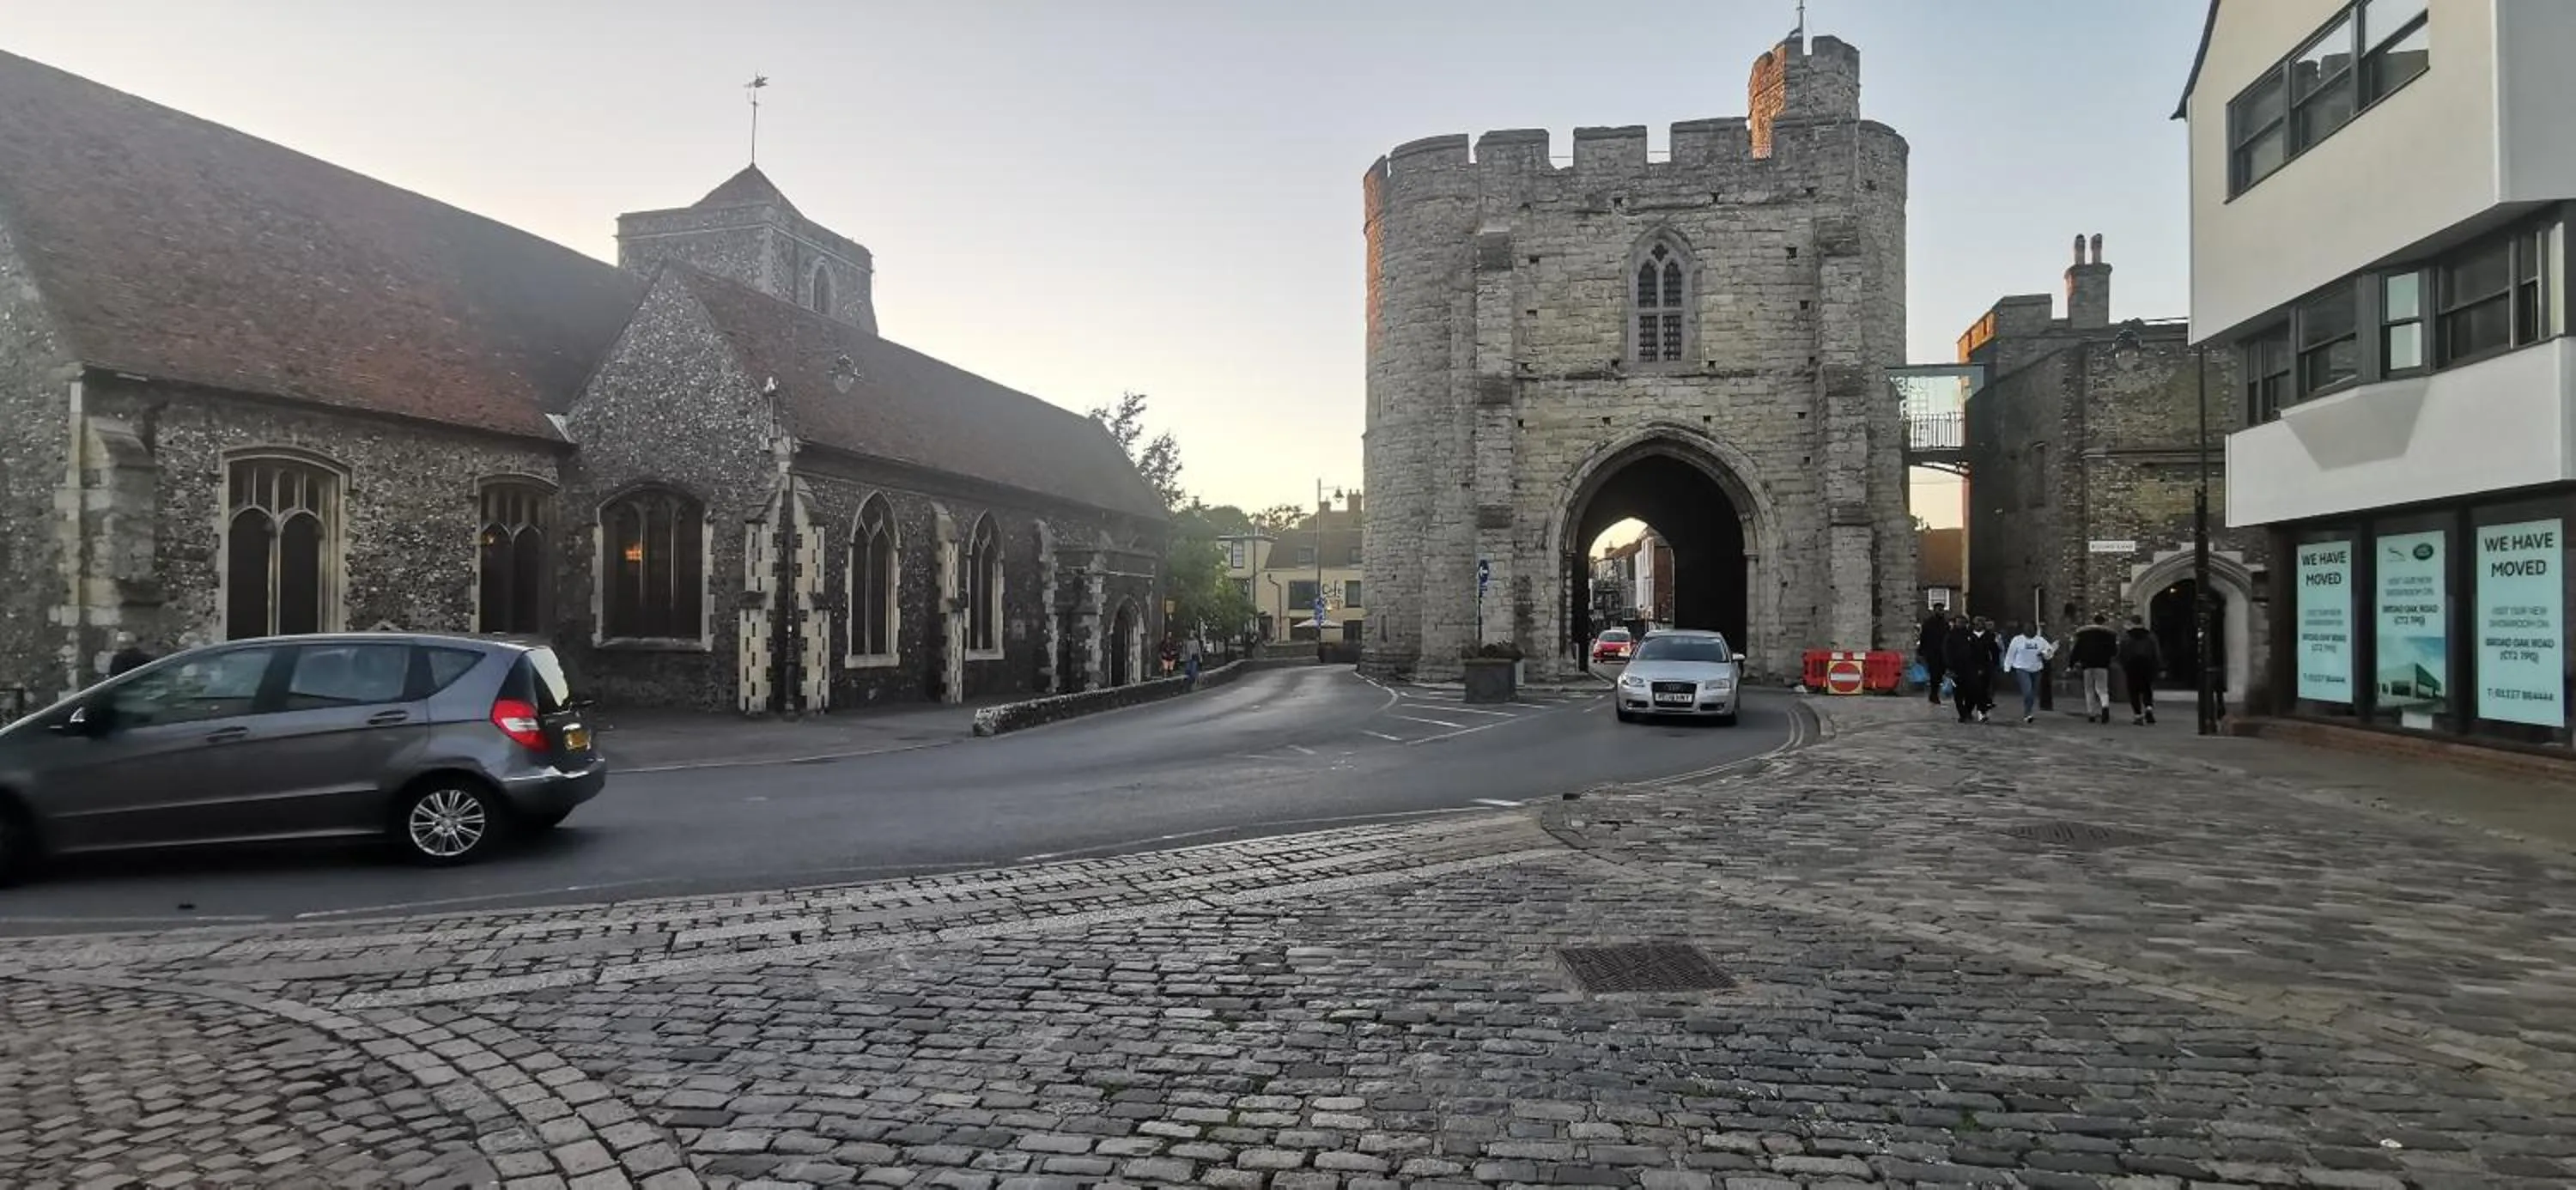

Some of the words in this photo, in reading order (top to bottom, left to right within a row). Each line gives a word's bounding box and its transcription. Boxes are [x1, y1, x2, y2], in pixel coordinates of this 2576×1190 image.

[2484, 536, 2508, 552] WE
[2512, 531, 2554, 550] HAVE
[2302, 554, 2317, 566] WE
[2319, 550, 2346, 565] HAVE
[2491, 559, 2547, 578] MOVED
[2306, 572, 2342, 586] MOVED
